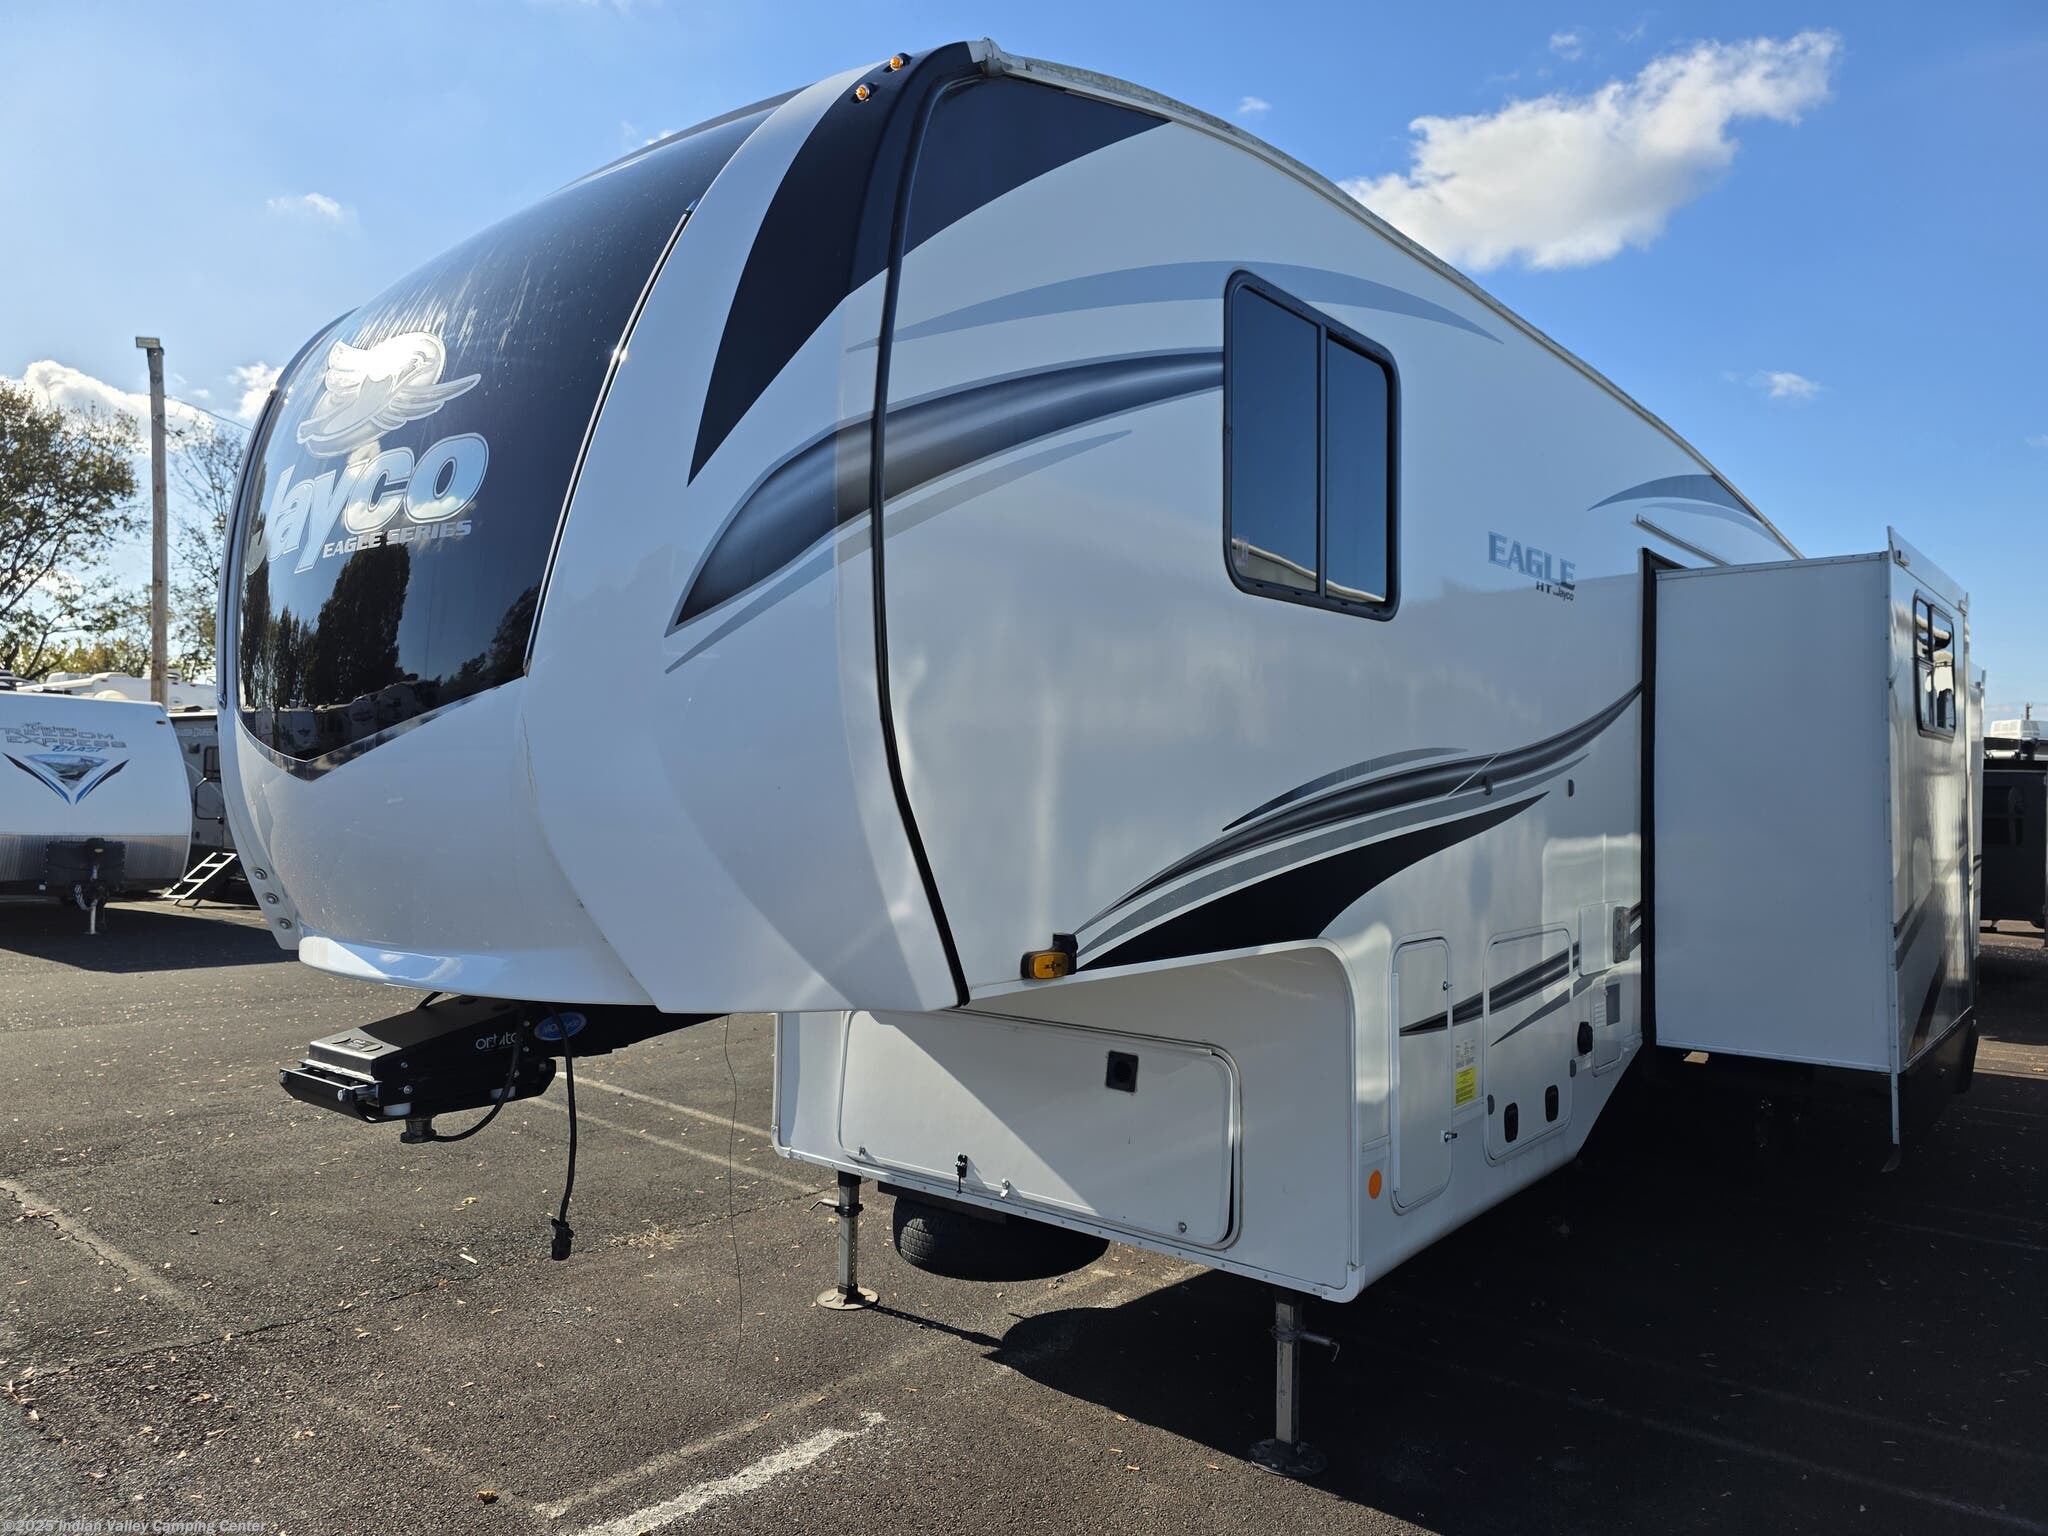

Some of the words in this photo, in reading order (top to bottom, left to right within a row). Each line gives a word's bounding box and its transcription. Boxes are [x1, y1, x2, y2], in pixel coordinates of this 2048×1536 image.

[246, 432, 489, 575] Jayco
[322, 530, 383, 559] EAGLE
[386, 519, 472, 546] SERIES
[1488, 530, 1576, 591] EAGLE
[1536, 581, 1552, 594] HT
[0, 727, 114, 740] REEDOM
